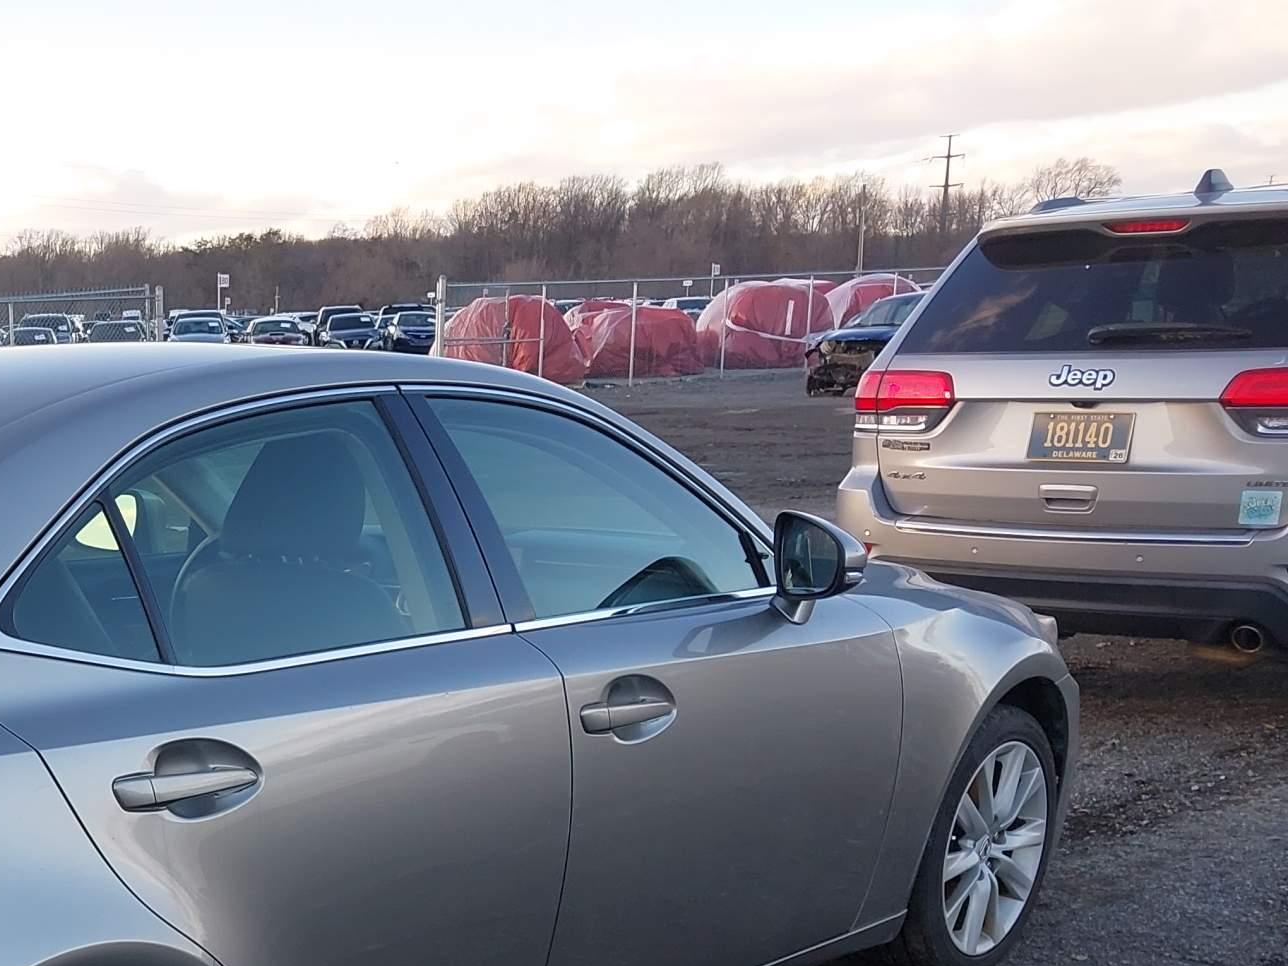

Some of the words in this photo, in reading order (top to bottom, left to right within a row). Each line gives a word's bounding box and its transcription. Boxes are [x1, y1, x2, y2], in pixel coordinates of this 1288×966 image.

[1049, 365, 1116, 390] Jeep
[1043, 421, 1113, 448] 181140
[1052, 450, 1097, 458] DELAWARE
